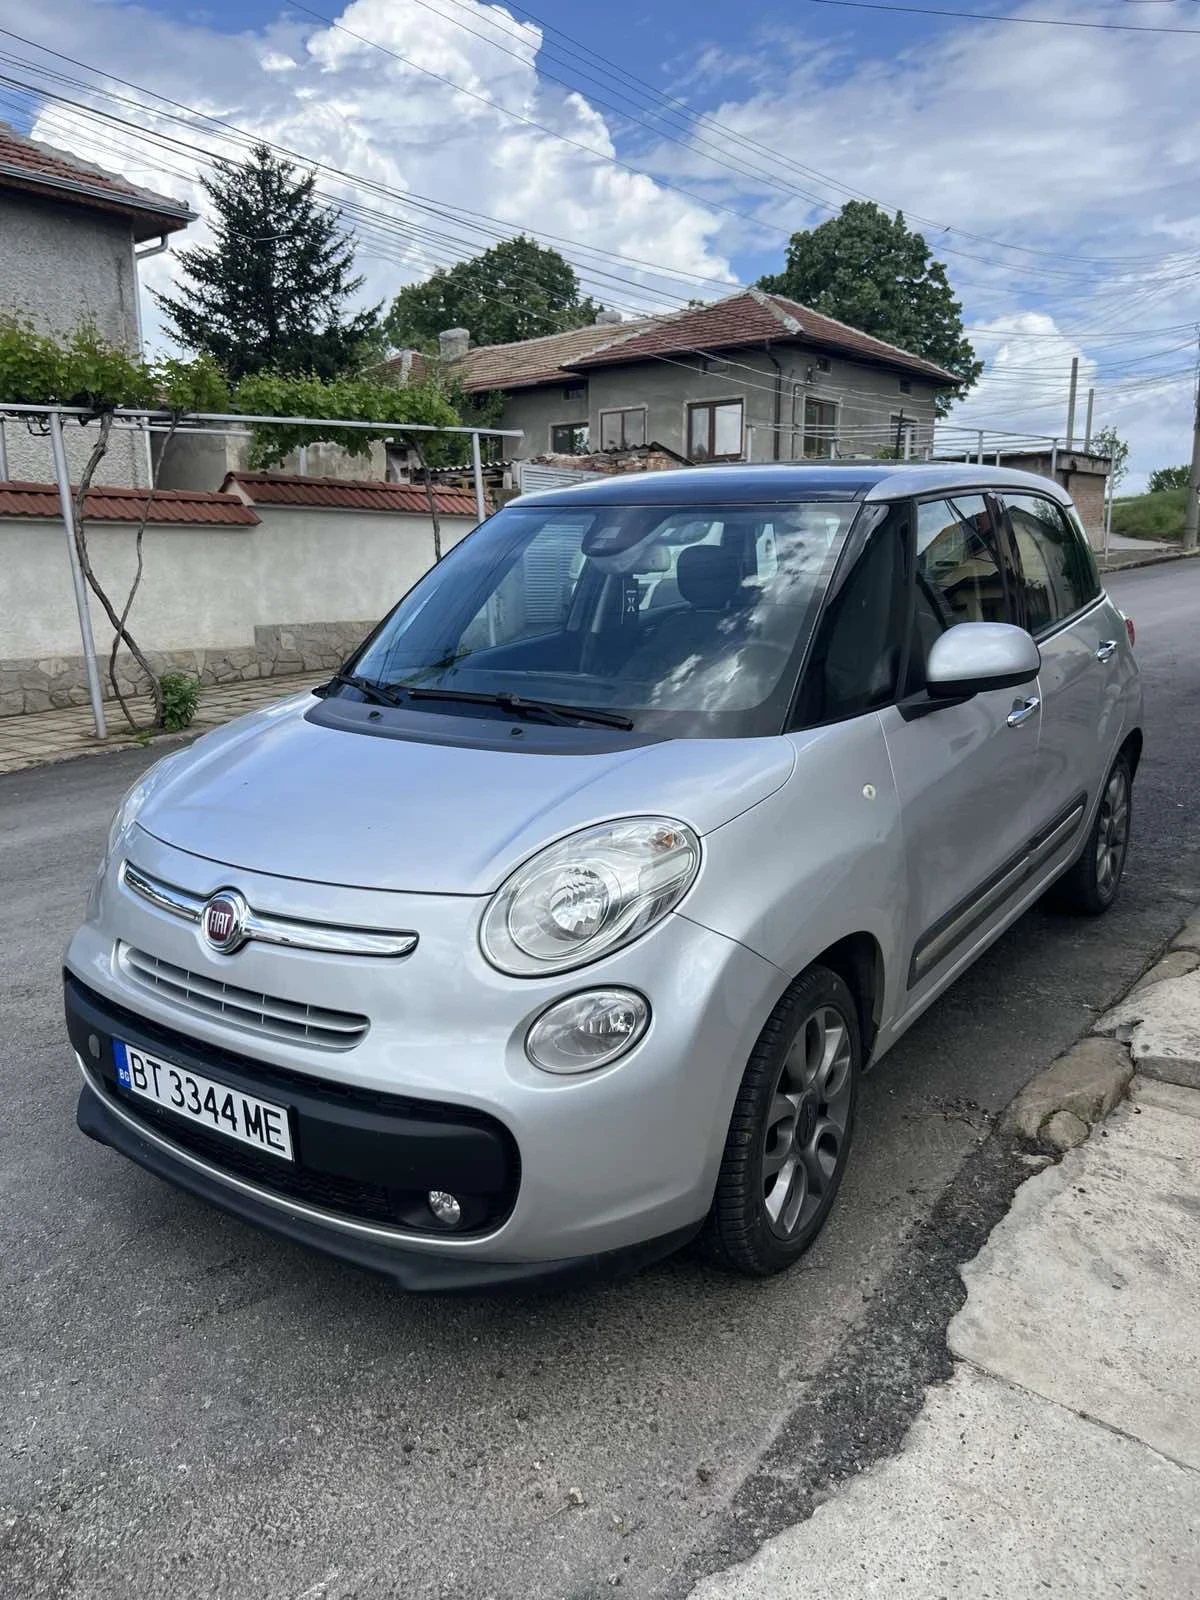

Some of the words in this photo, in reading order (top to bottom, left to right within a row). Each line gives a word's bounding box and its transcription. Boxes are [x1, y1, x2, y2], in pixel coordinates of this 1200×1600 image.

[210, 910, 231, 935] FIAT
[119, 1068, 130, 1082] BG
[130, 1052, 161, 1098] BT
[169, 1071, 238, 1132] 3344
[242, 1099, 286, 1151] ME
